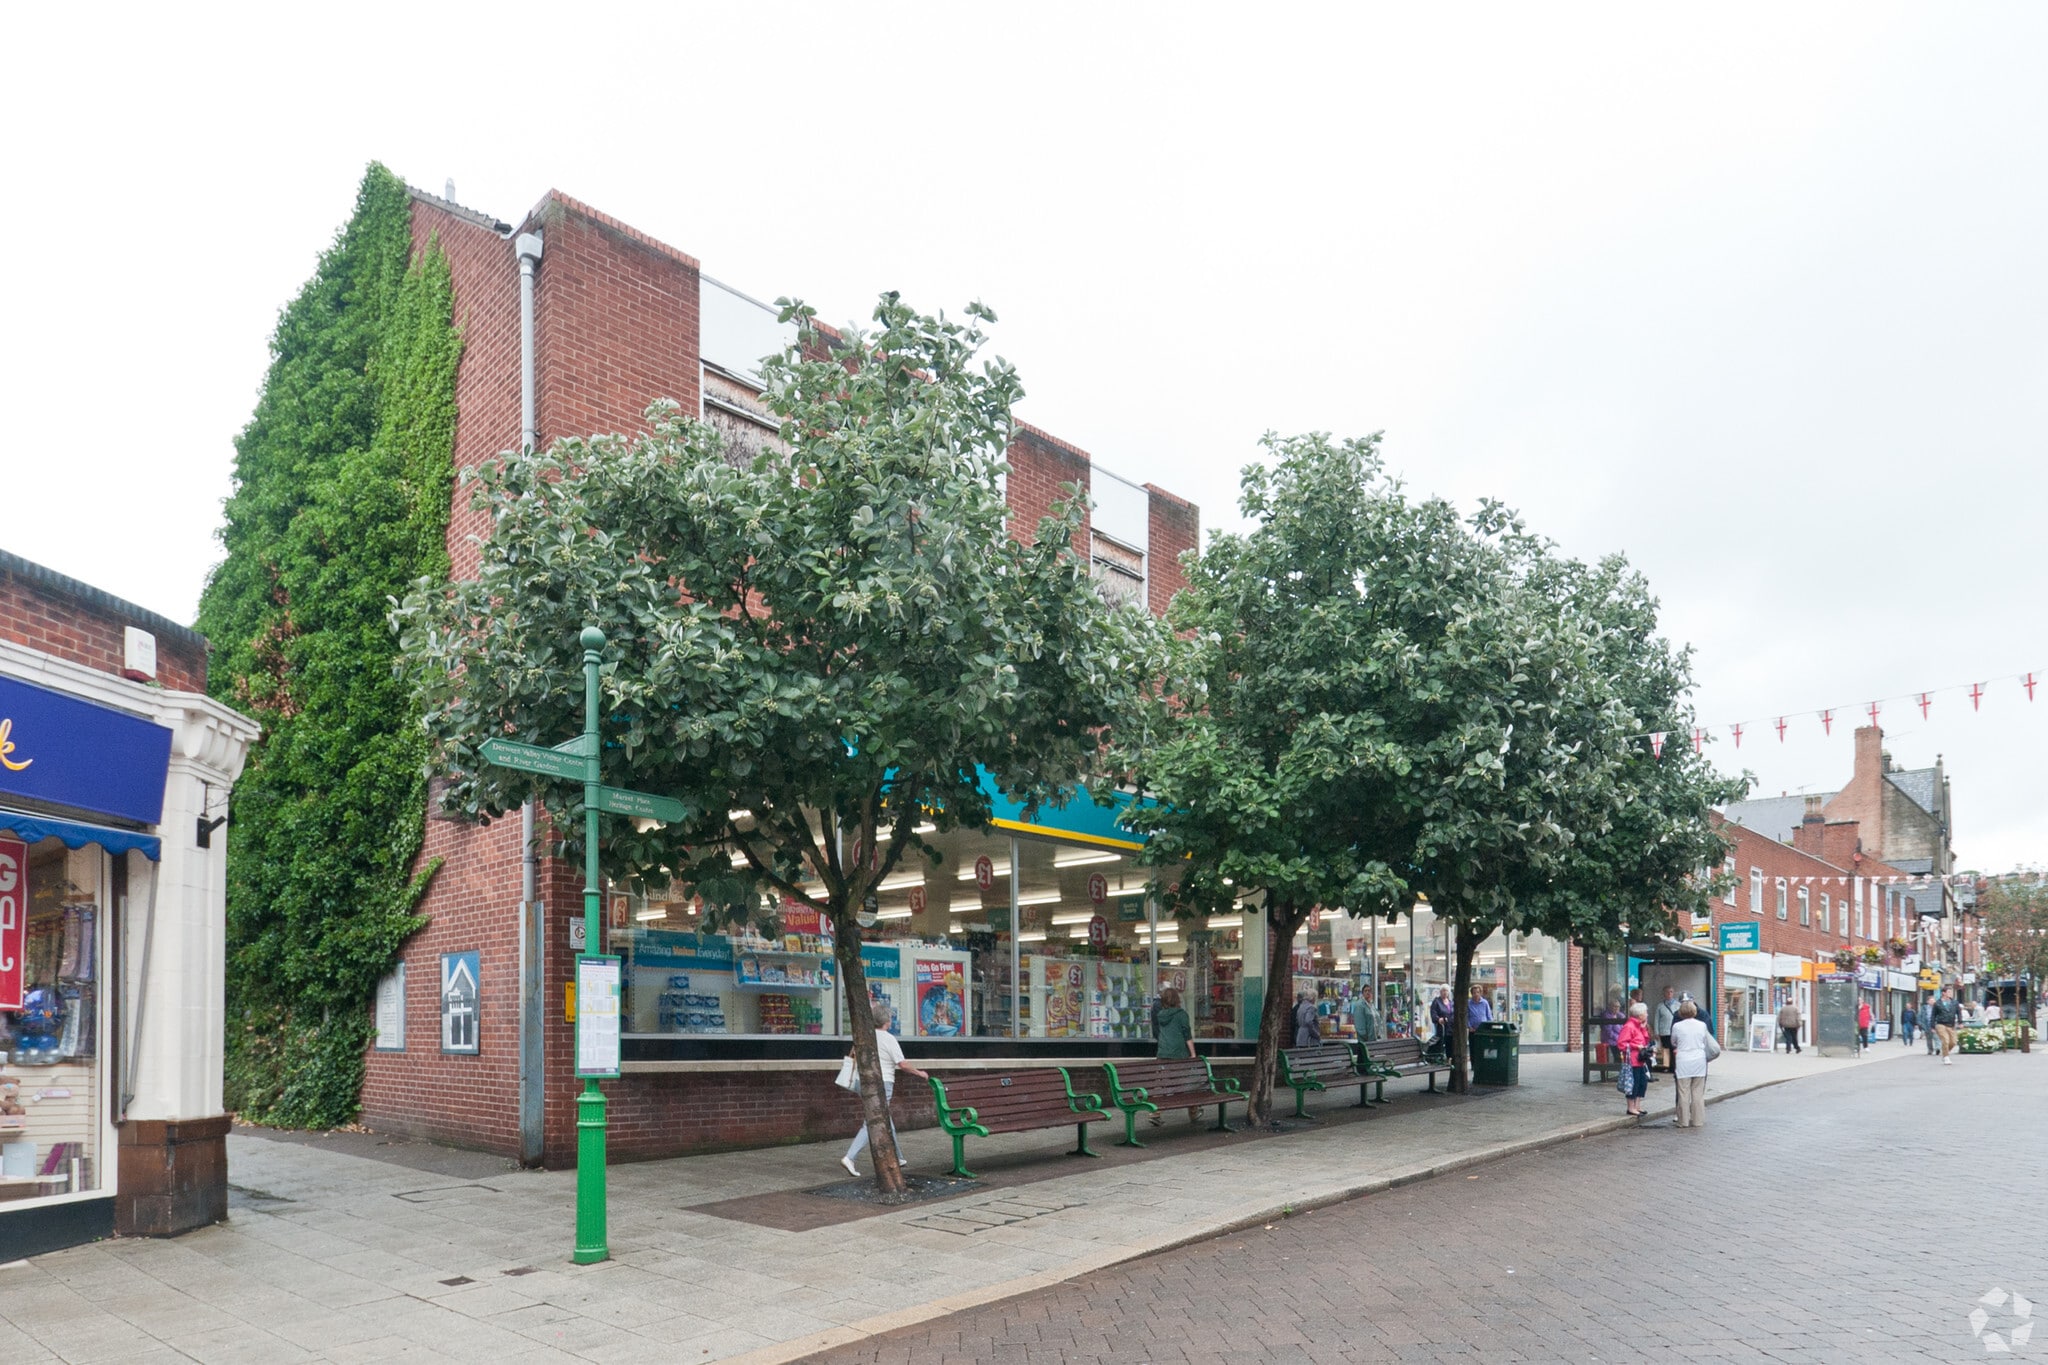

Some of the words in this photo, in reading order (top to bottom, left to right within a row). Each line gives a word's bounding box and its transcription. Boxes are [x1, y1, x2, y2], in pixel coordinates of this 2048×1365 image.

[492, 743, 521, 755] Derwent
[522, 748, 541, 759] Valley
[498, 755, 511, 763] and
[513, 757, 532, 766] River
[534, 761, 560, 771] Gardens
[978, 863, 992, 885] £1
[1091, 880, 1105, 899] £1
[911, 890, 924, 909] £1
[787, 912, 819, 926] Value!
[1091, 922, 1106, 941] £1
[639, 943, 671, 956] Amazing
[697, 947, 730, 960] Everyday!
[872, 958, 898, 970] Everyday!
[917, 963, 930, 972] Kids
[931, 963, 939, 972] Go
[940, 962, 955, 972] Free!
[1070, 968, 1082, 986] £1
[1175, 975, 1185, 991] £1
